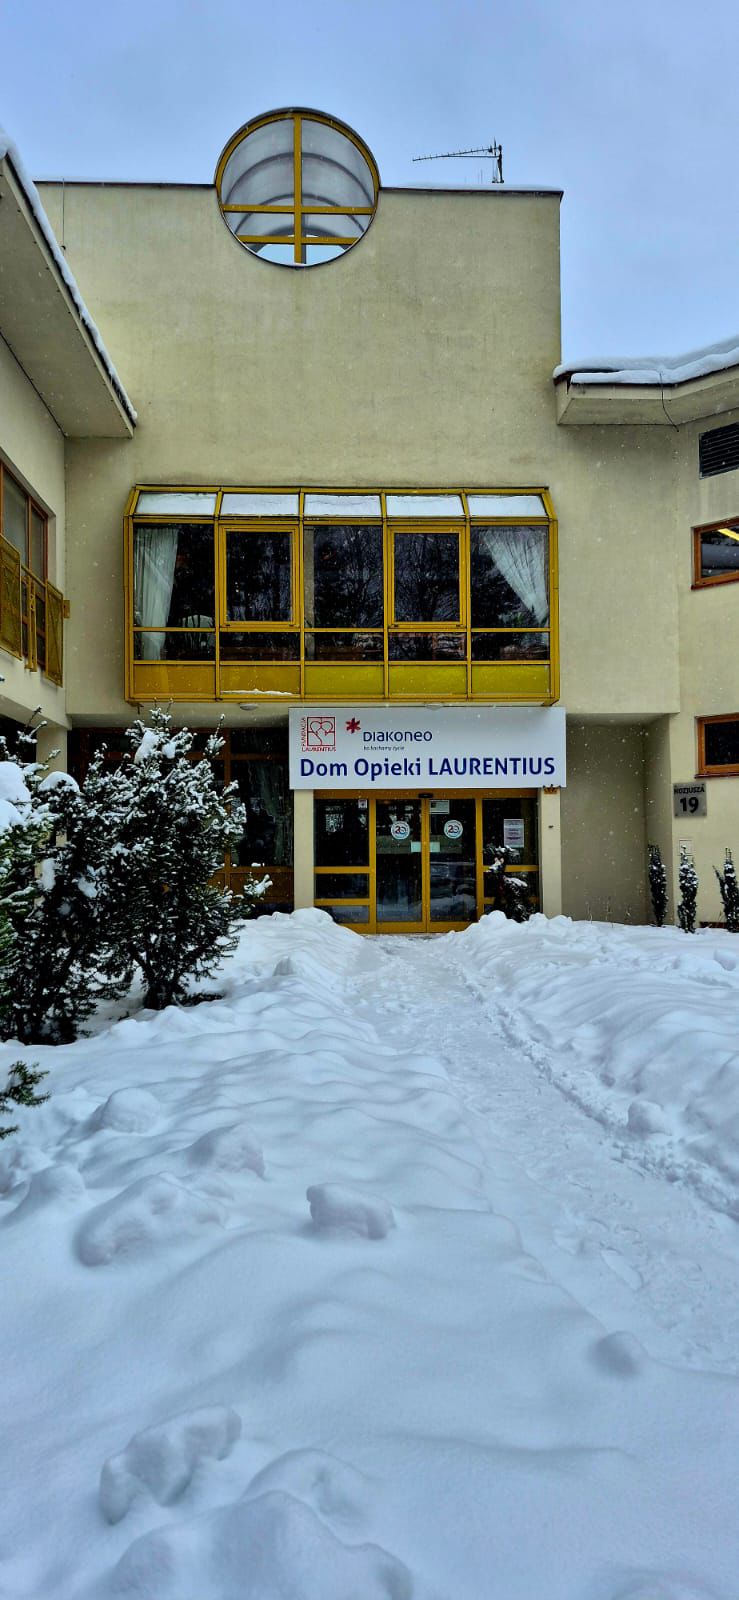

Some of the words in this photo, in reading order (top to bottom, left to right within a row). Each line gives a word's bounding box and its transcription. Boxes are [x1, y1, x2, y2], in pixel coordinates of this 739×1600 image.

[300, 758, 348, 777] Dom
[354, 757, 422, 781] Opieki
[428, 757, 555, 776] LAURENTIUS
[680, 797, 699, 813] 19
